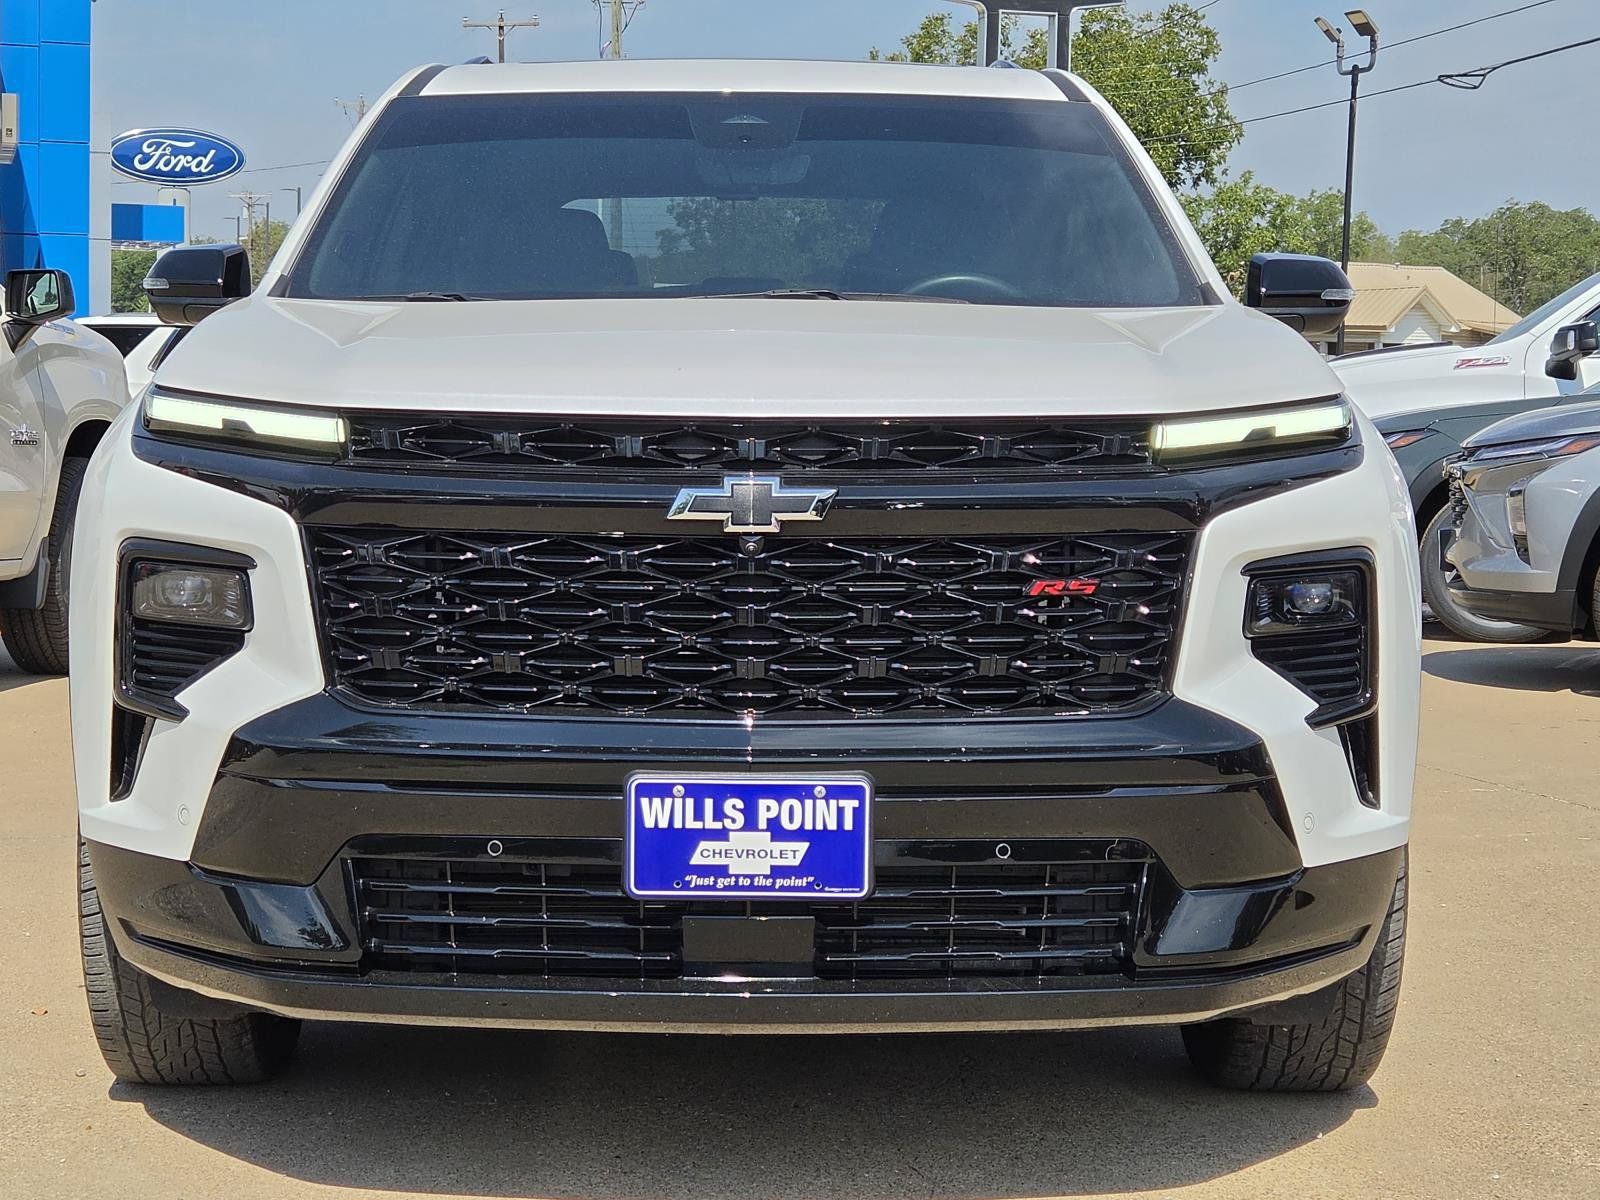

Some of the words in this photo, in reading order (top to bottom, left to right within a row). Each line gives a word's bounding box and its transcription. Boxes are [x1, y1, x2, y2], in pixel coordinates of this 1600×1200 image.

[133, 138, 217, 173] Ford
[1030, 580, 1096, 596] RS
[640, 797, 745, 830] WILLS
[758, 798, 860, 831] POINT
[699, 848, 801, 860] CHEVROLET
[716, 876, 736, 888] get
[738, 876, 751, 887] to
[754, 876, 773, 887] the
